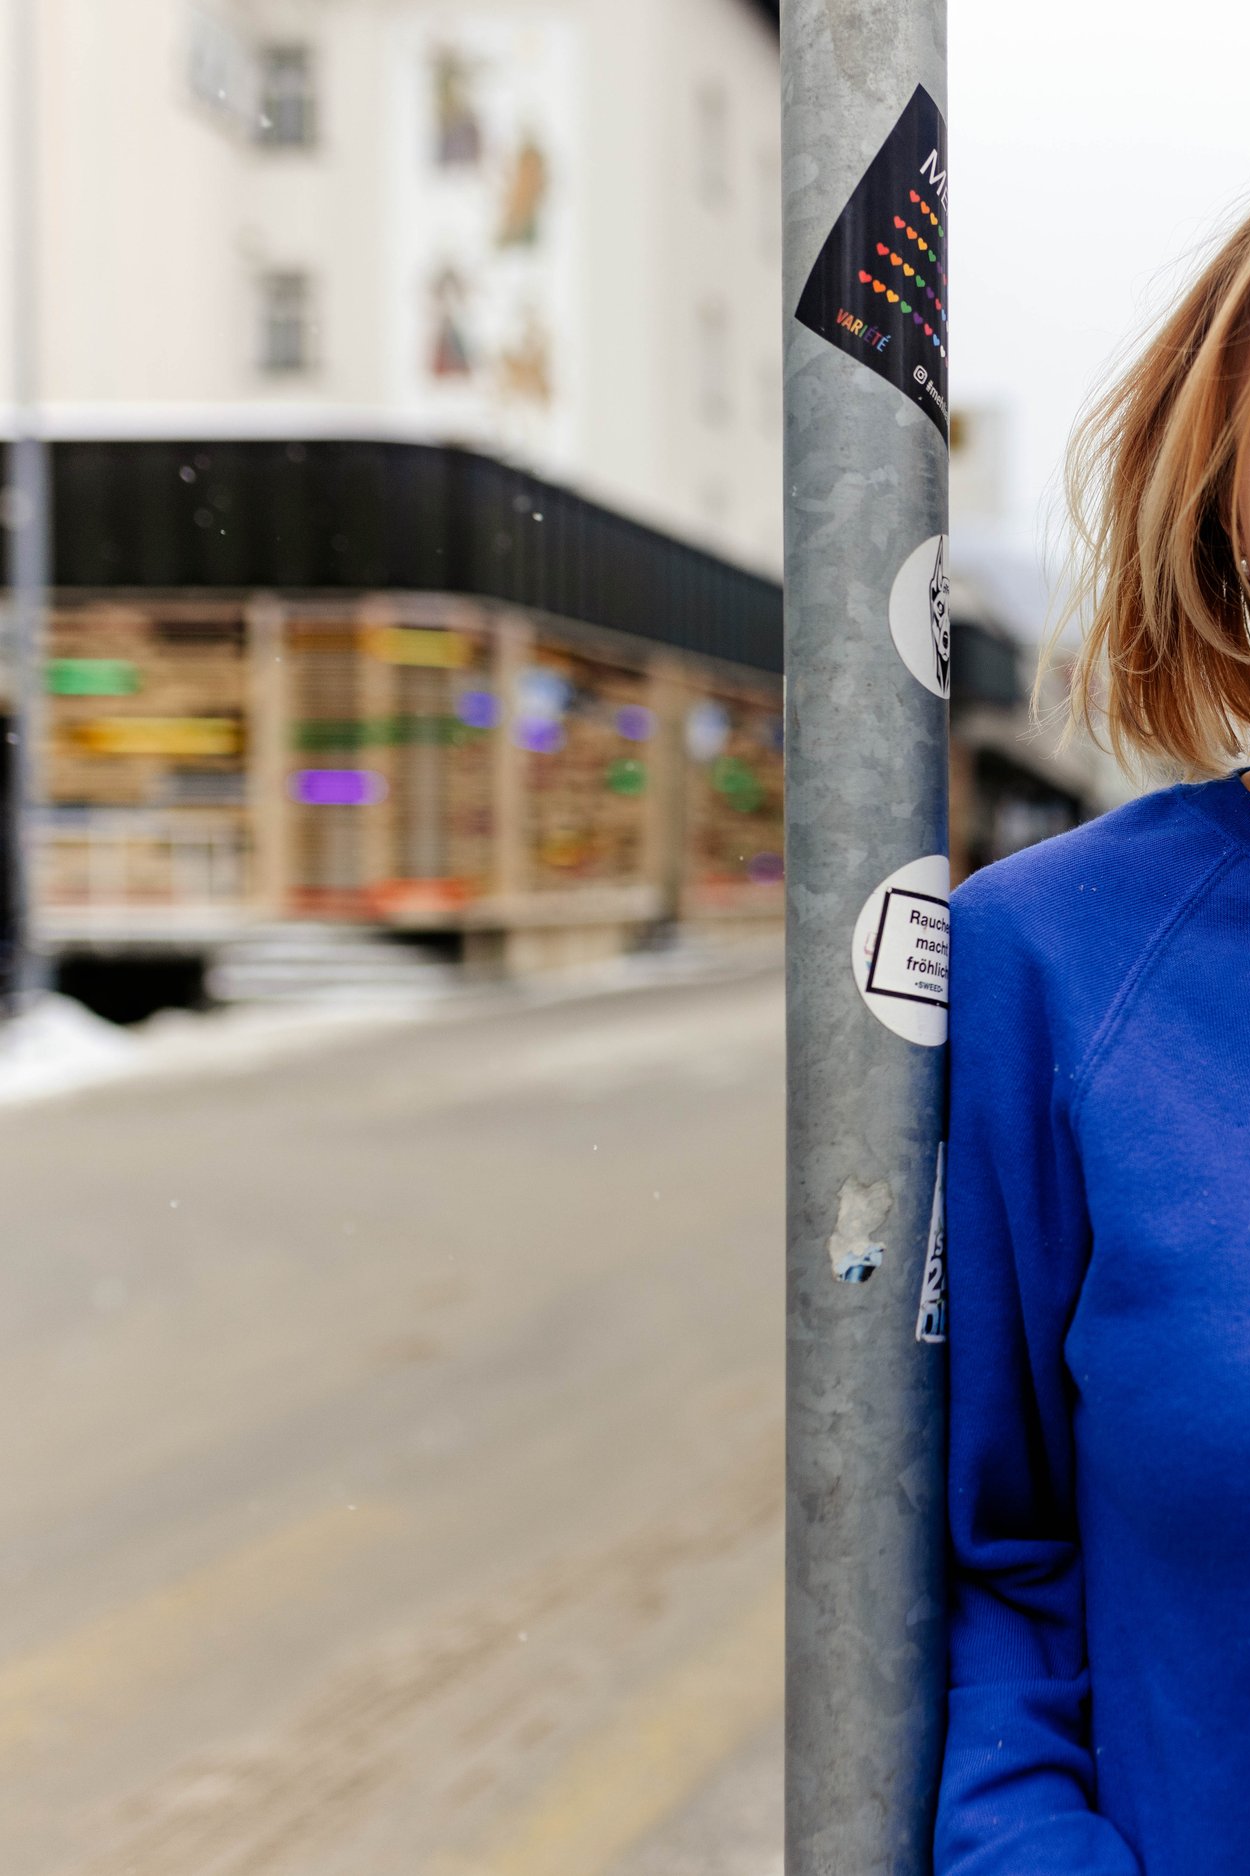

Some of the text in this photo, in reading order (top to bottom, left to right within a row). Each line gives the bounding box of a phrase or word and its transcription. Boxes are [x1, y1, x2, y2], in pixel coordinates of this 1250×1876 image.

[919, 148, 949, 215] ME
[836, 308, 891, 352] VARIÉTÉ
[915, 937, 949, 957] macht
